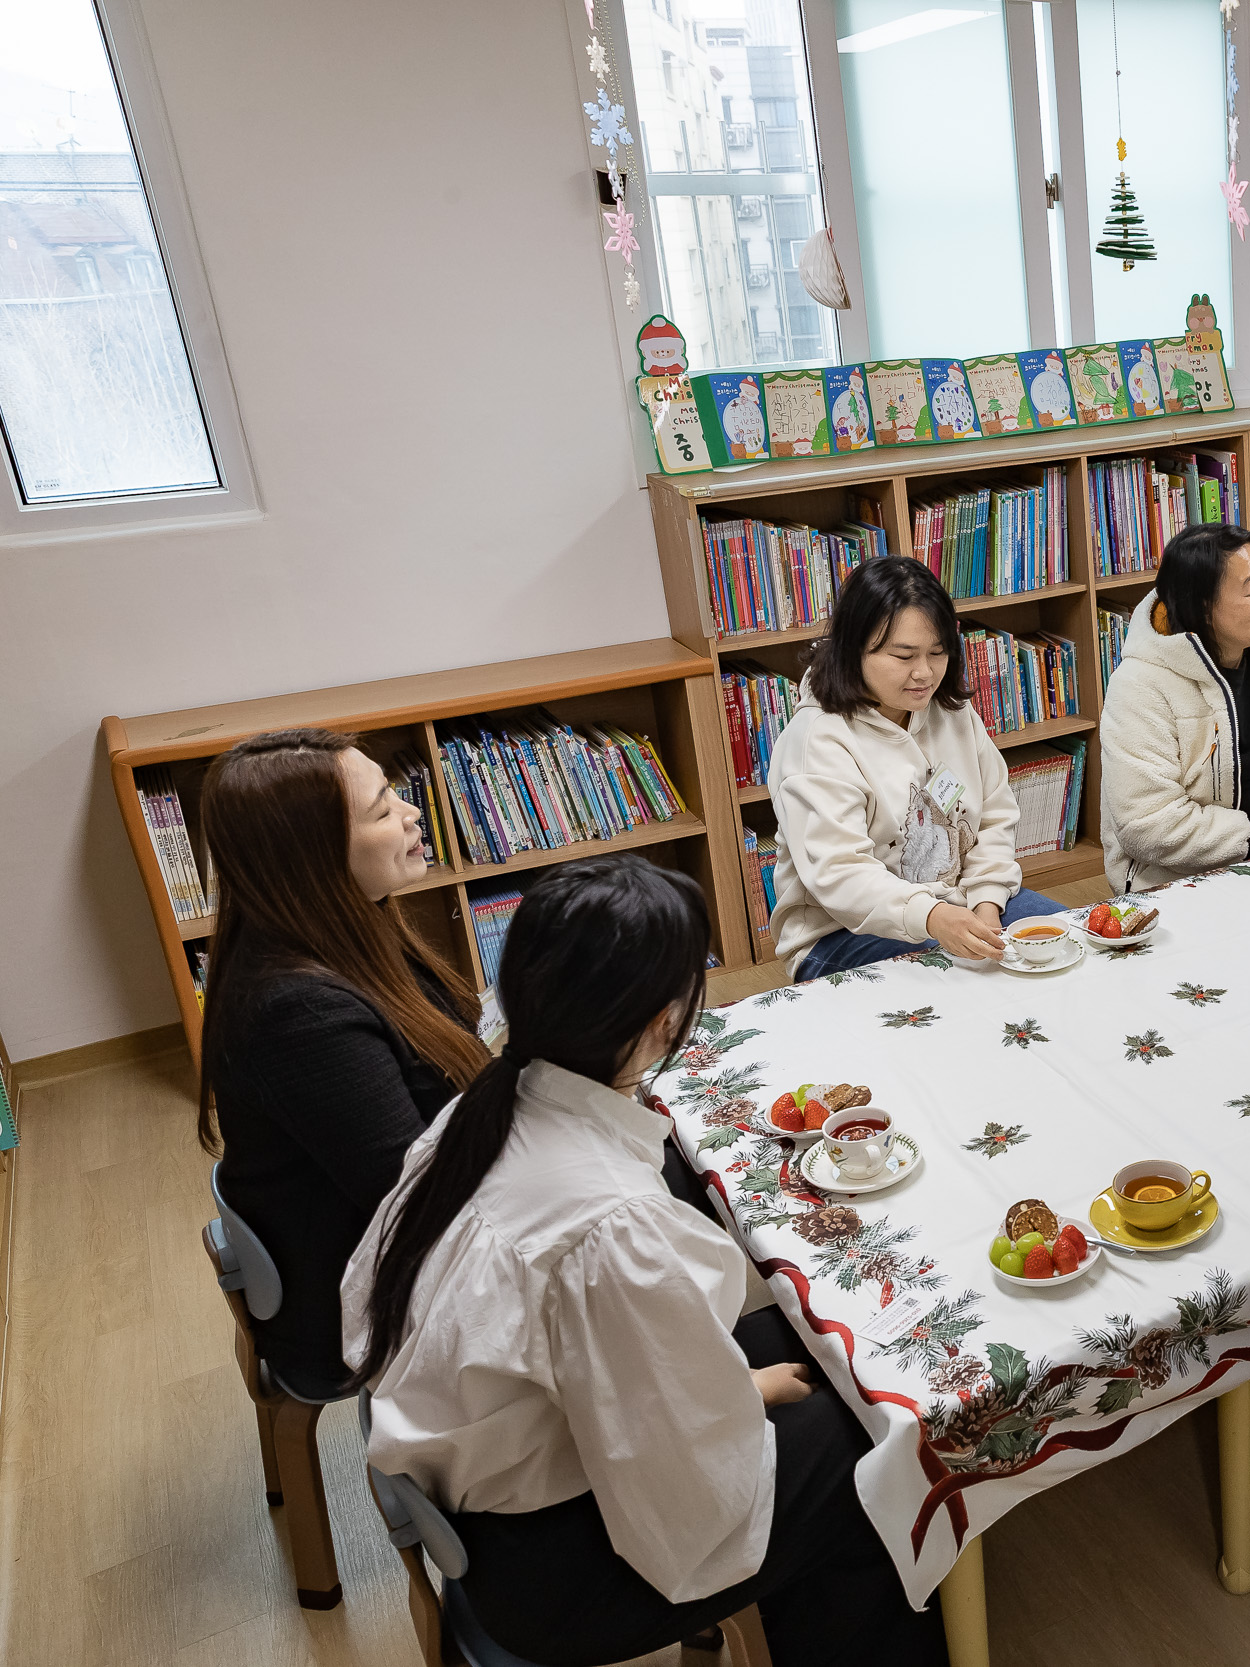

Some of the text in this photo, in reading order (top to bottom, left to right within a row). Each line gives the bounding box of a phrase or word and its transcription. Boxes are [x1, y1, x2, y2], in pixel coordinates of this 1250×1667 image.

[654, 389, 693, 402] Chris
[673, 416, 700, 425] Chris
[674, 433, 694, 461] 중
